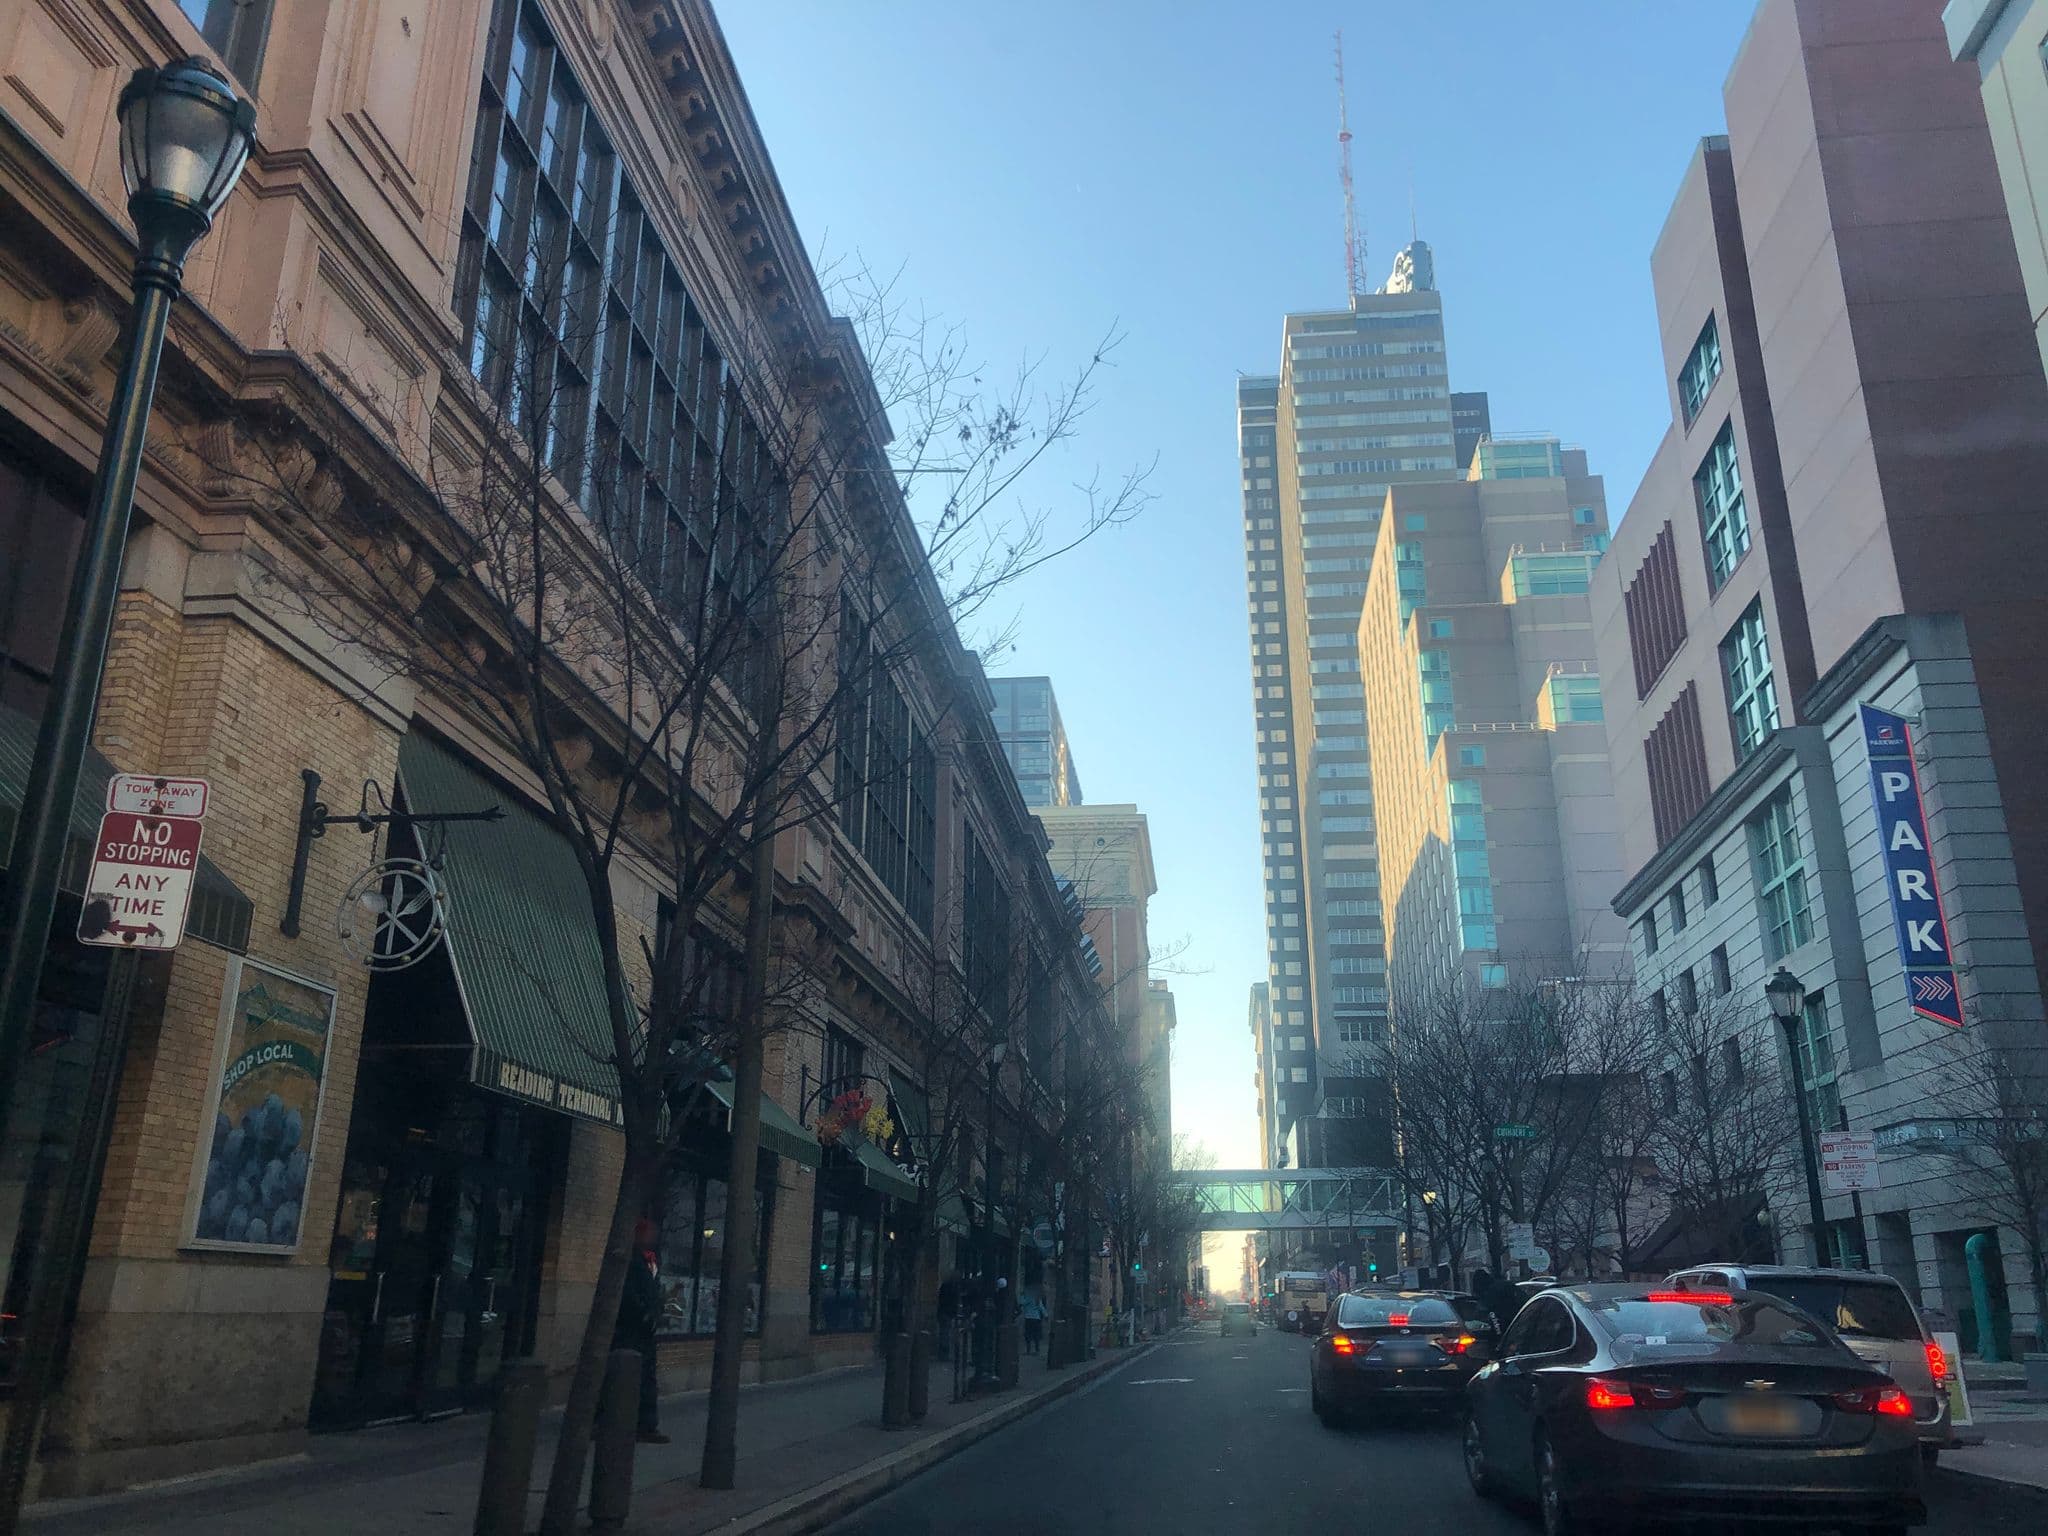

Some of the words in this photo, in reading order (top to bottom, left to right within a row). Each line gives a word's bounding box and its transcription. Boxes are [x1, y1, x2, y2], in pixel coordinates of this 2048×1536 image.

[125, 783, 198, 798] TOW-AWAY
[139, 798, 176, 809] ZONE
[132, 819, 172, 846] NO
[105, 842, 191, 866] STOPPING
[1880, 771, 1944, 952] PARK
[115, 873, 170, 892] ANY
[110, 896, 165, 916] TIME
[223, 1054, 254, 1091] SHOP
[257, 1044, 294, 1065] LOCAL
[500, 1062, 554, 1102] READING
[559, 1083, 612, 1122] TERMINAL
[1835, 1144, 1868, 1152] STOPPING
